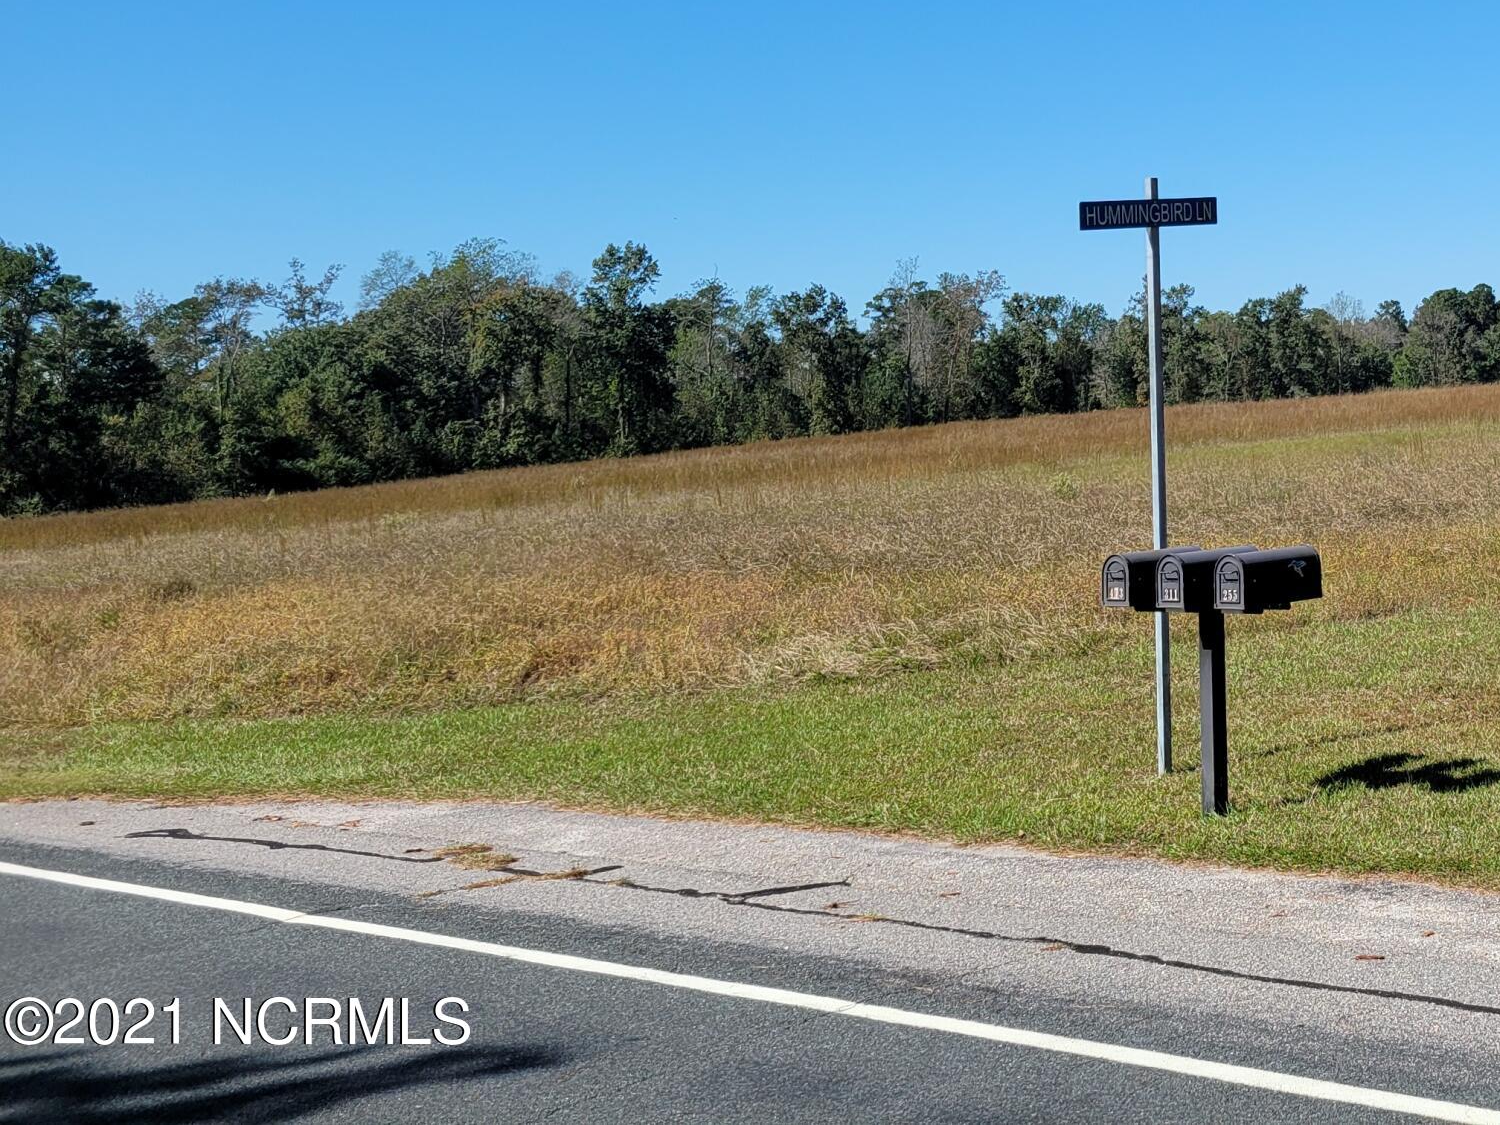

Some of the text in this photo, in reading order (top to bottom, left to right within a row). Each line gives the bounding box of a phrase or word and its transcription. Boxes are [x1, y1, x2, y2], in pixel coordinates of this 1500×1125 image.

[1086, 201, 1212, 226] HUMMINGBIRD LN
[1222, 589, 1238, 601] 255
